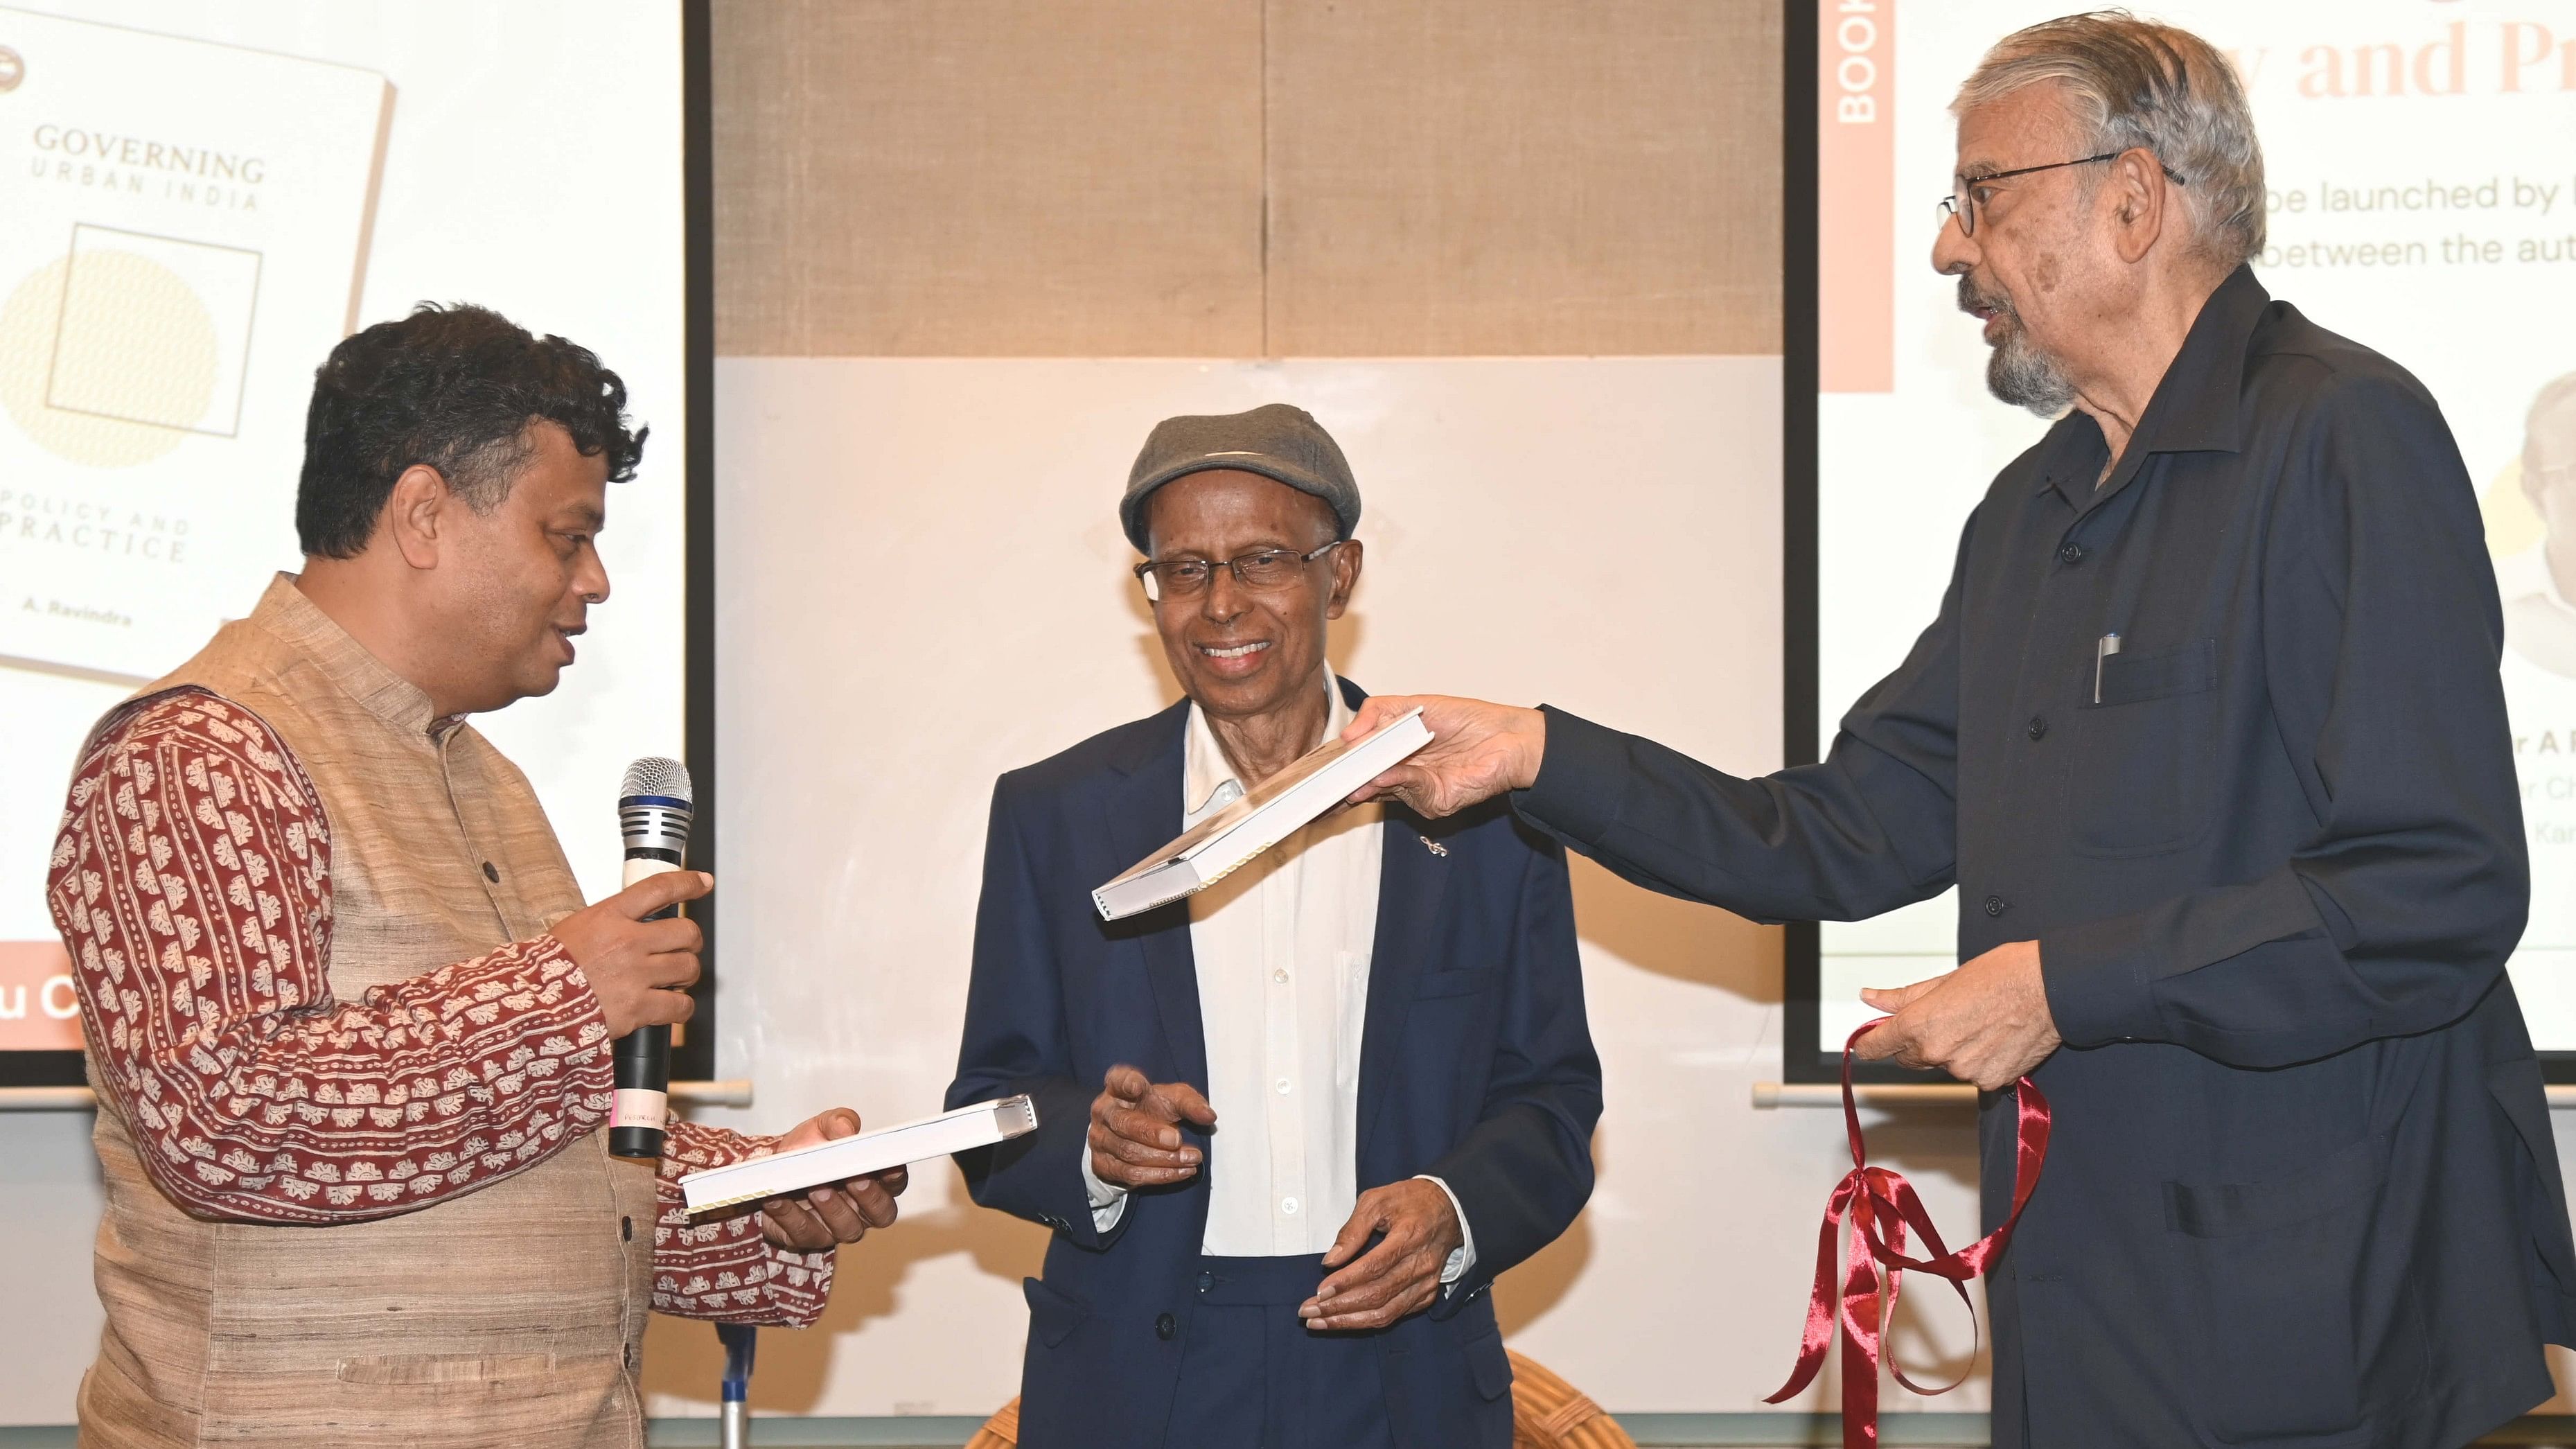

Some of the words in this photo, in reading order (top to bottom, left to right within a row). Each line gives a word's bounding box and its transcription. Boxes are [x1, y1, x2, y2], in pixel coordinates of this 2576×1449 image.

[2297, 19, 2467, 98] and
[33, 123, 265, 184] GOVERNING
[31, 155, 144, 195] URBAN
[164, 178, 258, 211] INDIA
[2321, 177, 2498, 212] launched
[2514, 176, 2560, 216] by
[2260, 236, 2426, 267] between
[2443, 233, 2503, 265] the
[0, 489, 113, 522] POLICY
[129, 511, 189, 536] AND
[0, 511, 186, 564] PRACTICE
[22, 596, 39, 613] A.
[48, 599, 133, 628] Ravindra
[2539, 730, 2559, 754] A
